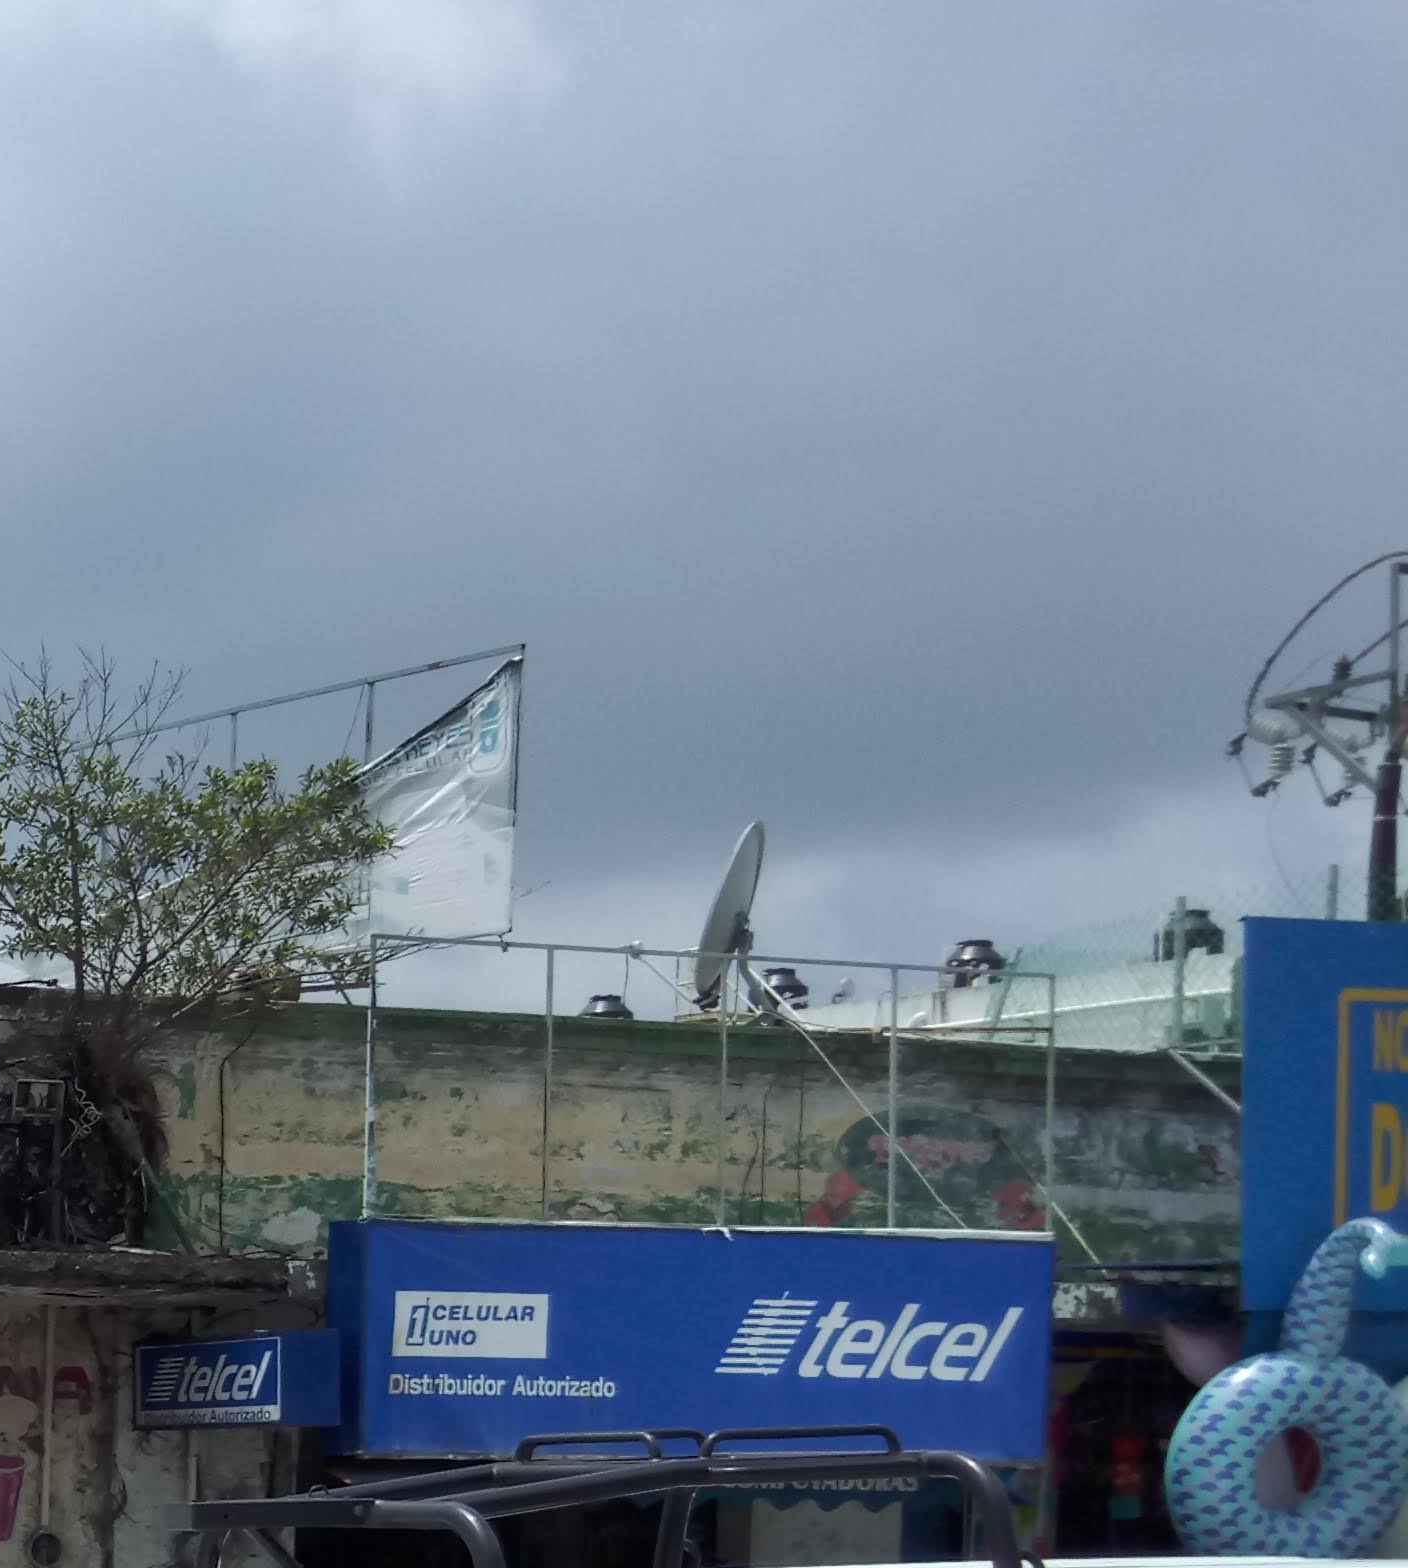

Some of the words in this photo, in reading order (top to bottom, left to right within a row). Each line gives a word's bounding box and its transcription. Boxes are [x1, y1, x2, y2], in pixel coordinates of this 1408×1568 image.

[431, 1304, 536, 1323] CELULAR
[428, 1329, 477, 1347] UNO
[798, 1300, 1024, 1382] telcel
[177, 1350, 272, 1402] telcel
[389, 1374, 506, 1396] Distribuidor
[513, 1374, 617, 1400] Autorizado
[210, 1409, 271, 1423] Autorizado
